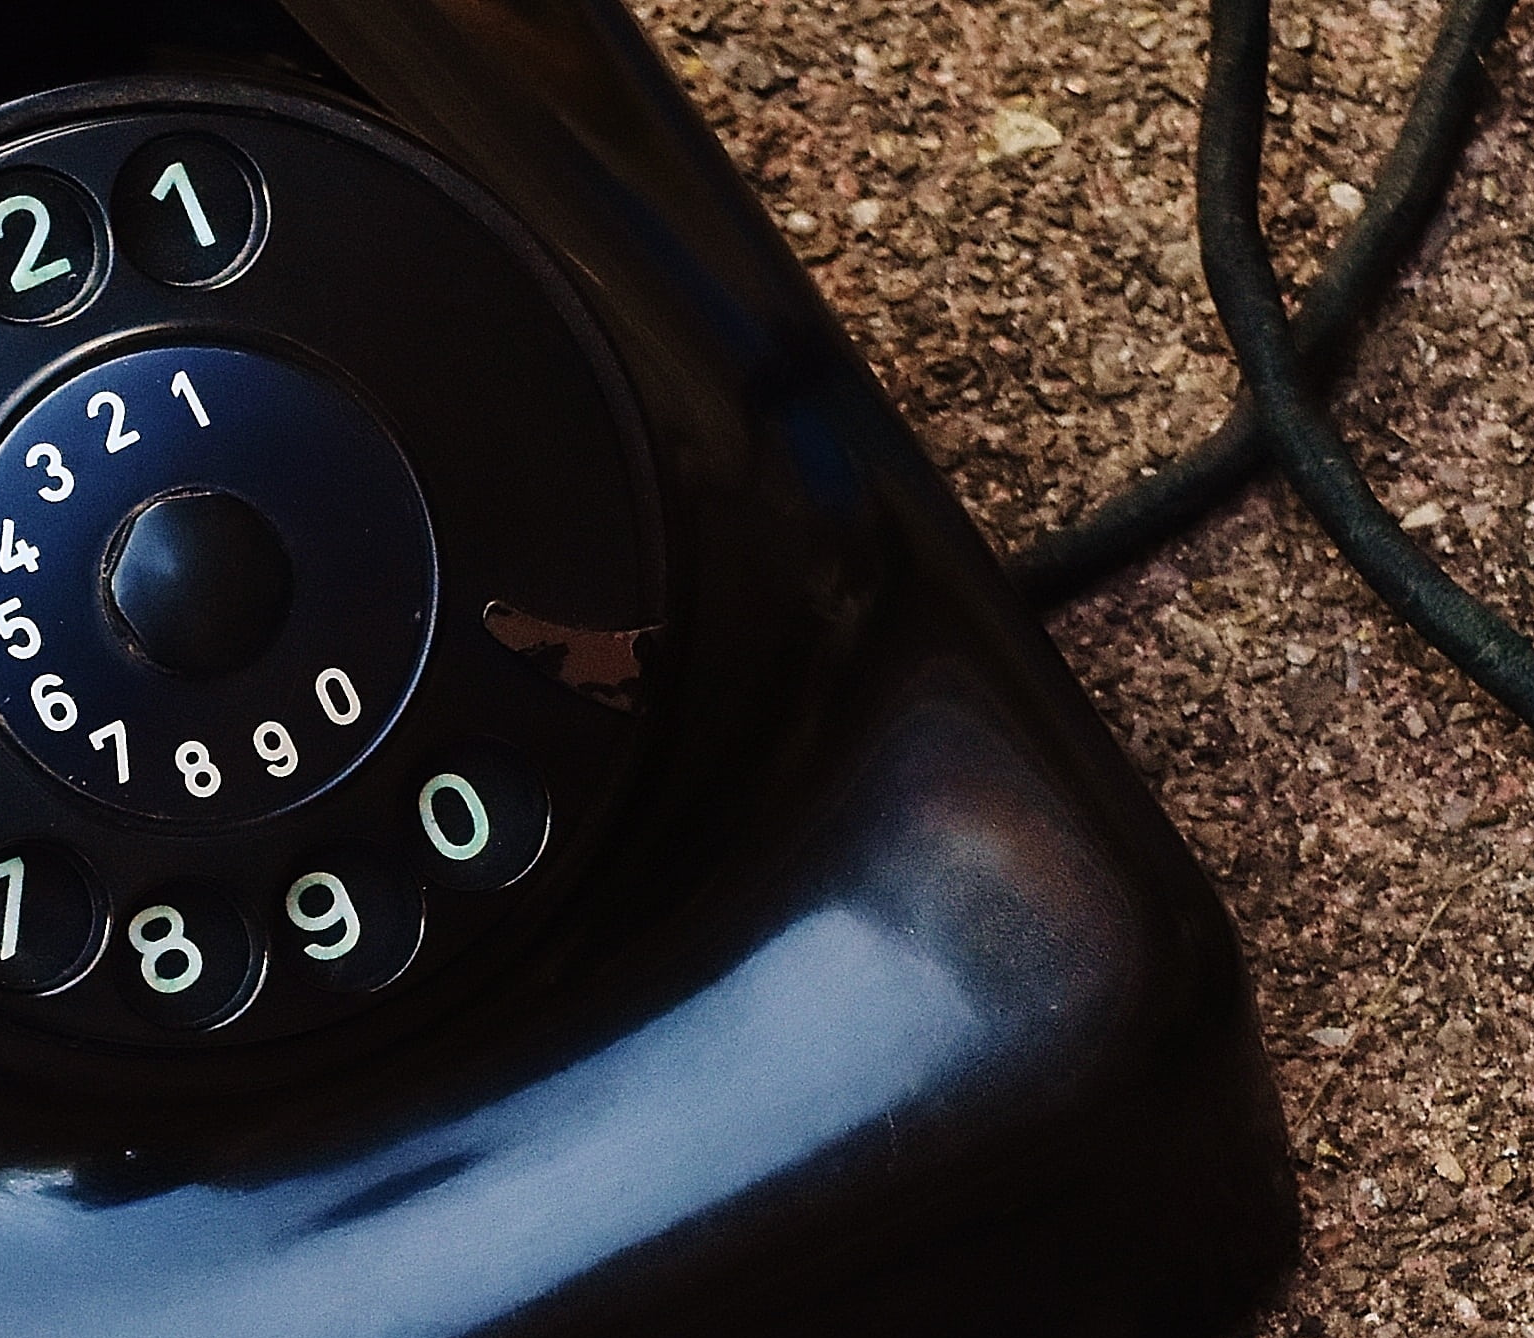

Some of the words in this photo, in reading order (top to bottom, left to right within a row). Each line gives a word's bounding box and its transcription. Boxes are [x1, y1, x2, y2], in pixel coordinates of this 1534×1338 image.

[151, 163, 215, 246] 1
[87, 391, 140, 453] 2
[171, 371, 210, 427] 1
[25, 442, 75, 502] 3
[0, 518, 40, 573] 4
[31, 674, 77, 731] 6
[316, 668, 361, 725] 0
[89, 720, 129, 783] 7
[175, 741, 221, 797] 8
[253, 721, 298, 777] 9
[419, 774, 489, 860] 0
[287, 872, 360, 960] 9
[129, 906, 202, 993] 8
